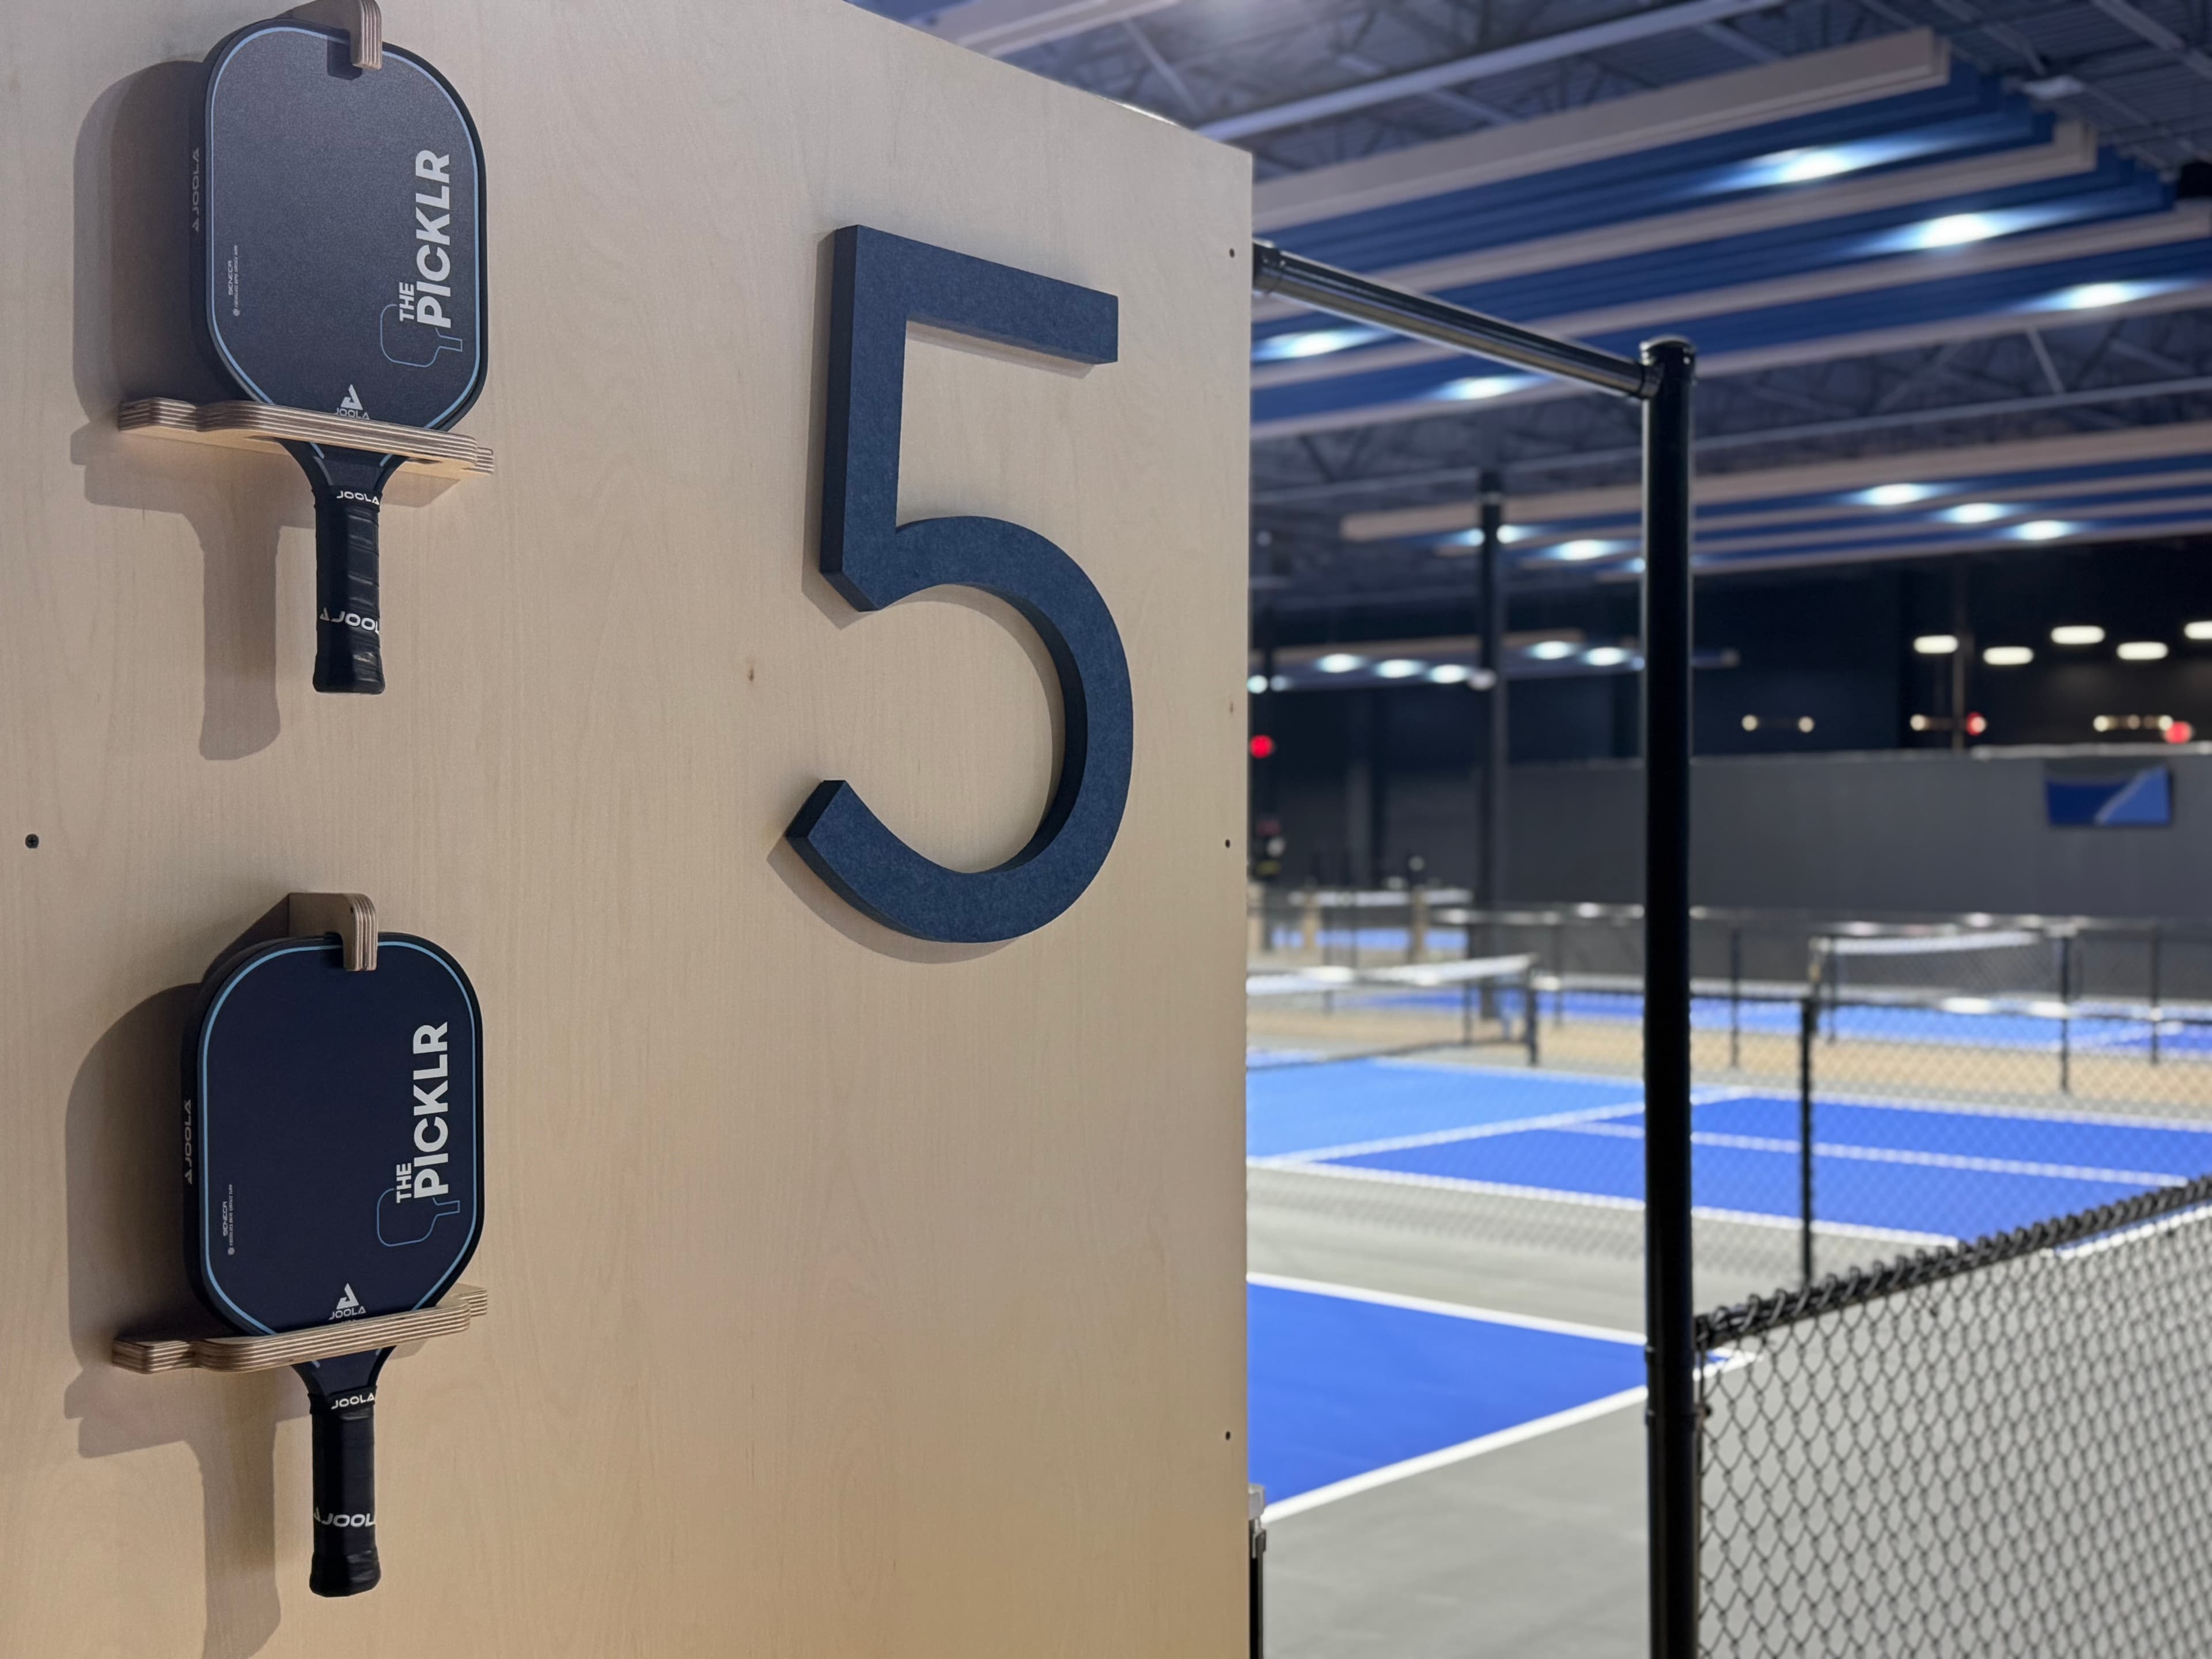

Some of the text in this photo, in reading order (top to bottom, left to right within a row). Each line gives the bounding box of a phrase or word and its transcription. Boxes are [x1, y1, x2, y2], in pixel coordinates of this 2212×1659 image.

[415, 150, 451, 328] PICKLR
[399, 282, 414, 321] THE
[334, 407, 370, 420] JOOLA
[336, 491, 380, 505] JOOLA
[785, 224, 1134, 944] 5
[331, 611, 380, 634] JOOL
[413, 1021, 449, 1198] PICKLR
[184, 1099, 192, 1167] JOOLA
[396, 1162, 412, 1203] THE
[328, 1306, 366, 1320] JOOLA
[331, 1392, 375, 1407] JOOLA
[321, 1513, 375, 1527] JOOL
